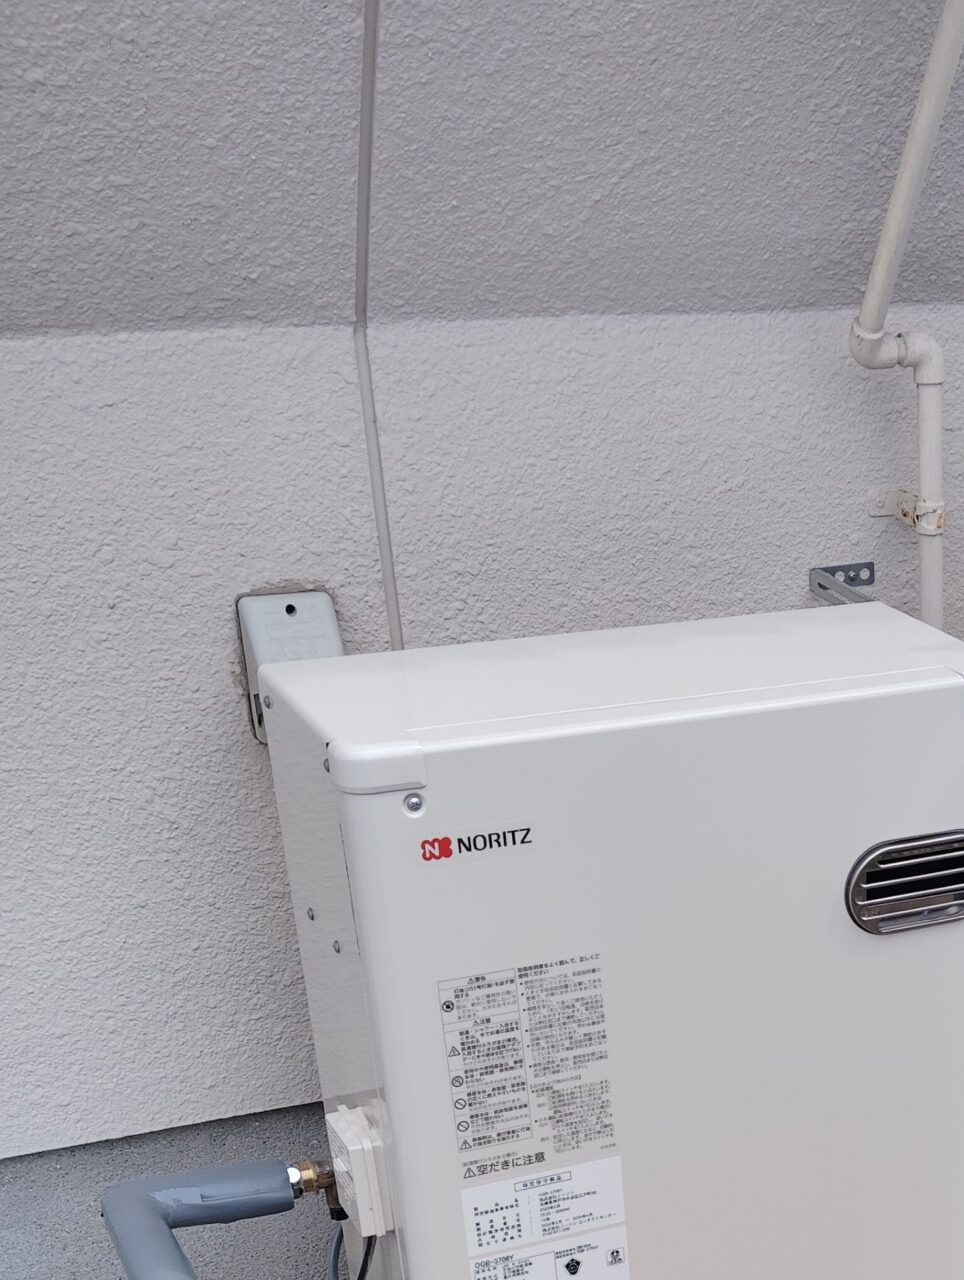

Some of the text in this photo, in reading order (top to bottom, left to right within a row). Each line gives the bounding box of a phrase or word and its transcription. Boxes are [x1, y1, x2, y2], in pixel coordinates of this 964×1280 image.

[457, 827, 532, 854] NORITZ
[474, 1151, 546, 1176] 空だきに注意
